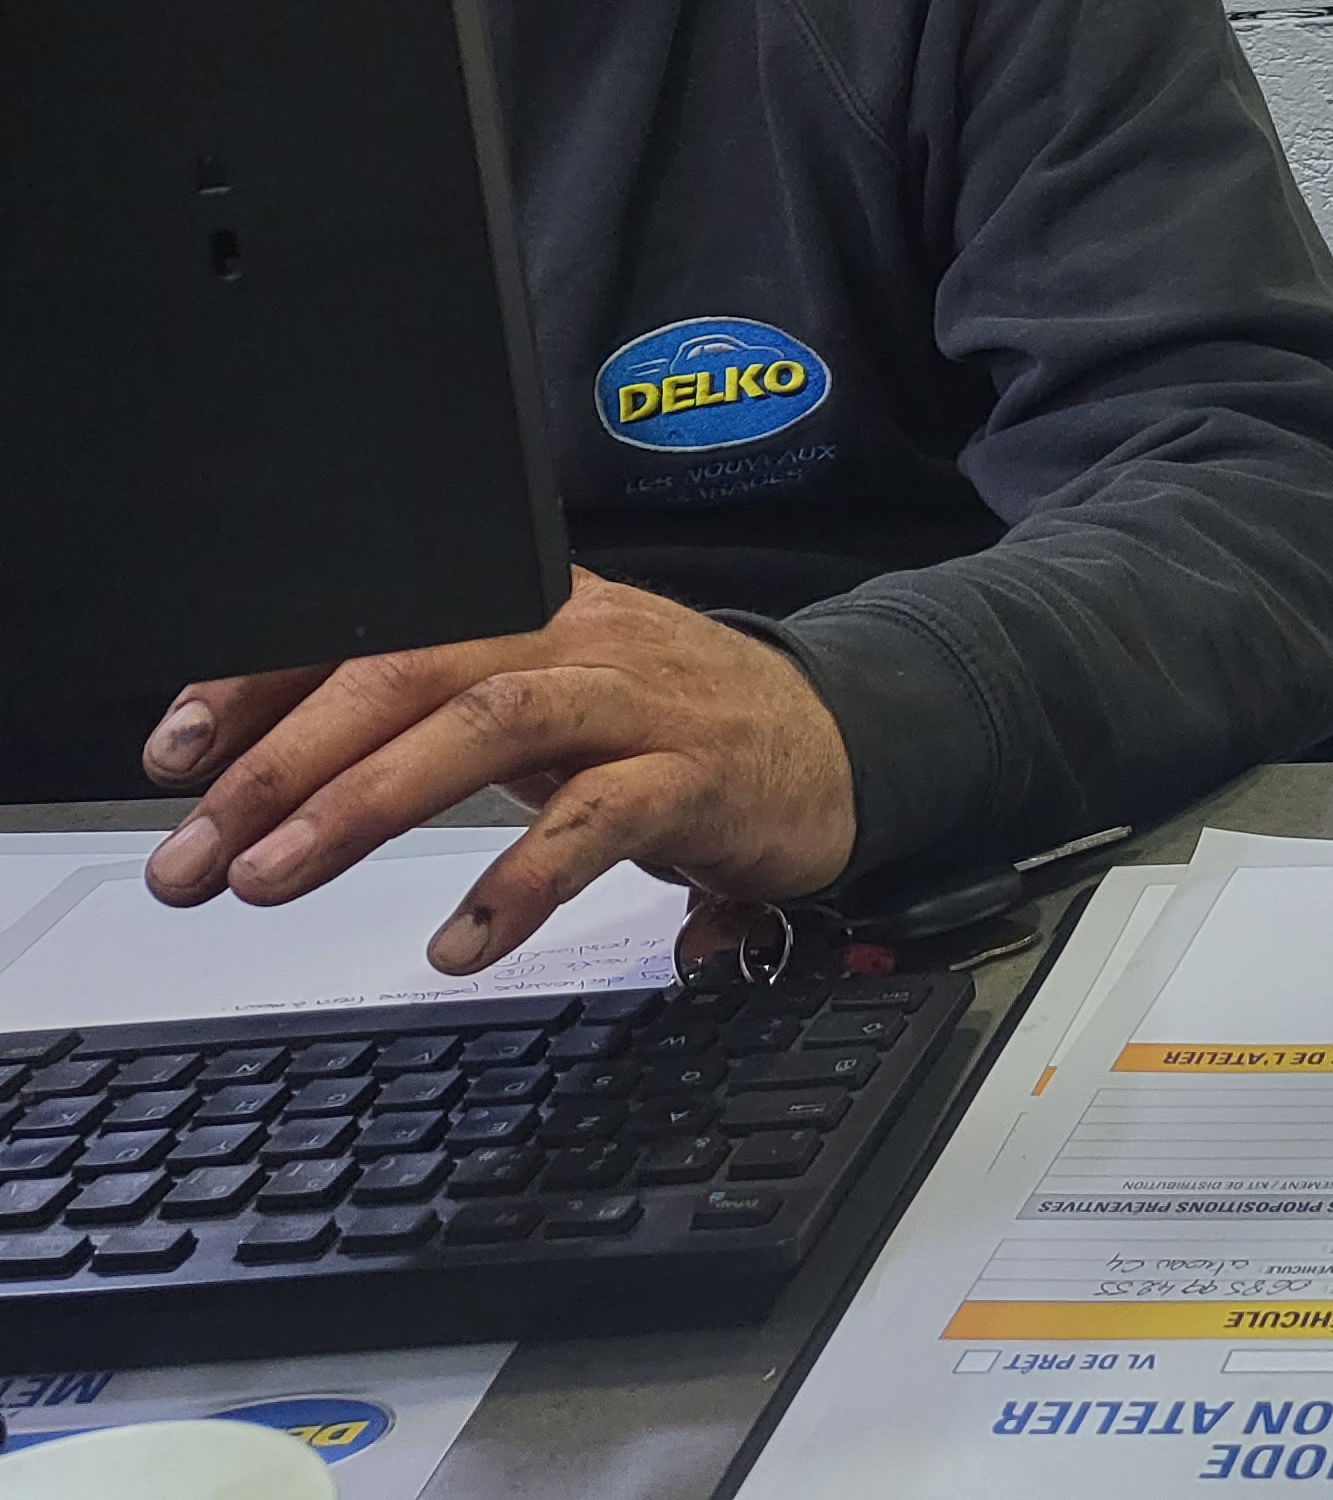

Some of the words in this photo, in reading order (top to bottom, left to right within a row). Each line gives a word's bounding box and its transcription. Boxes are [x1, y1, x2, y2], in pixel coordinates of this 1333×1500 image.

[617, 360, 808, 424] DELKO
[1162, 1050, 1285, 1065] L'ATELIER
[1294, 1051, 1326, 1065] DE
[1037, 1201, 1172, 1216] PRÉVENTIVES
[1176, 1201, 1323, 1213] PROPOSITIONS
[1003, 1353, 1076, 1374] PRÊT
[1078, 1353, 1119, 1371] DE
[1124, 1353, 1156, 1371] VL
[992, 1401, 1235, 1436] ATELIER
